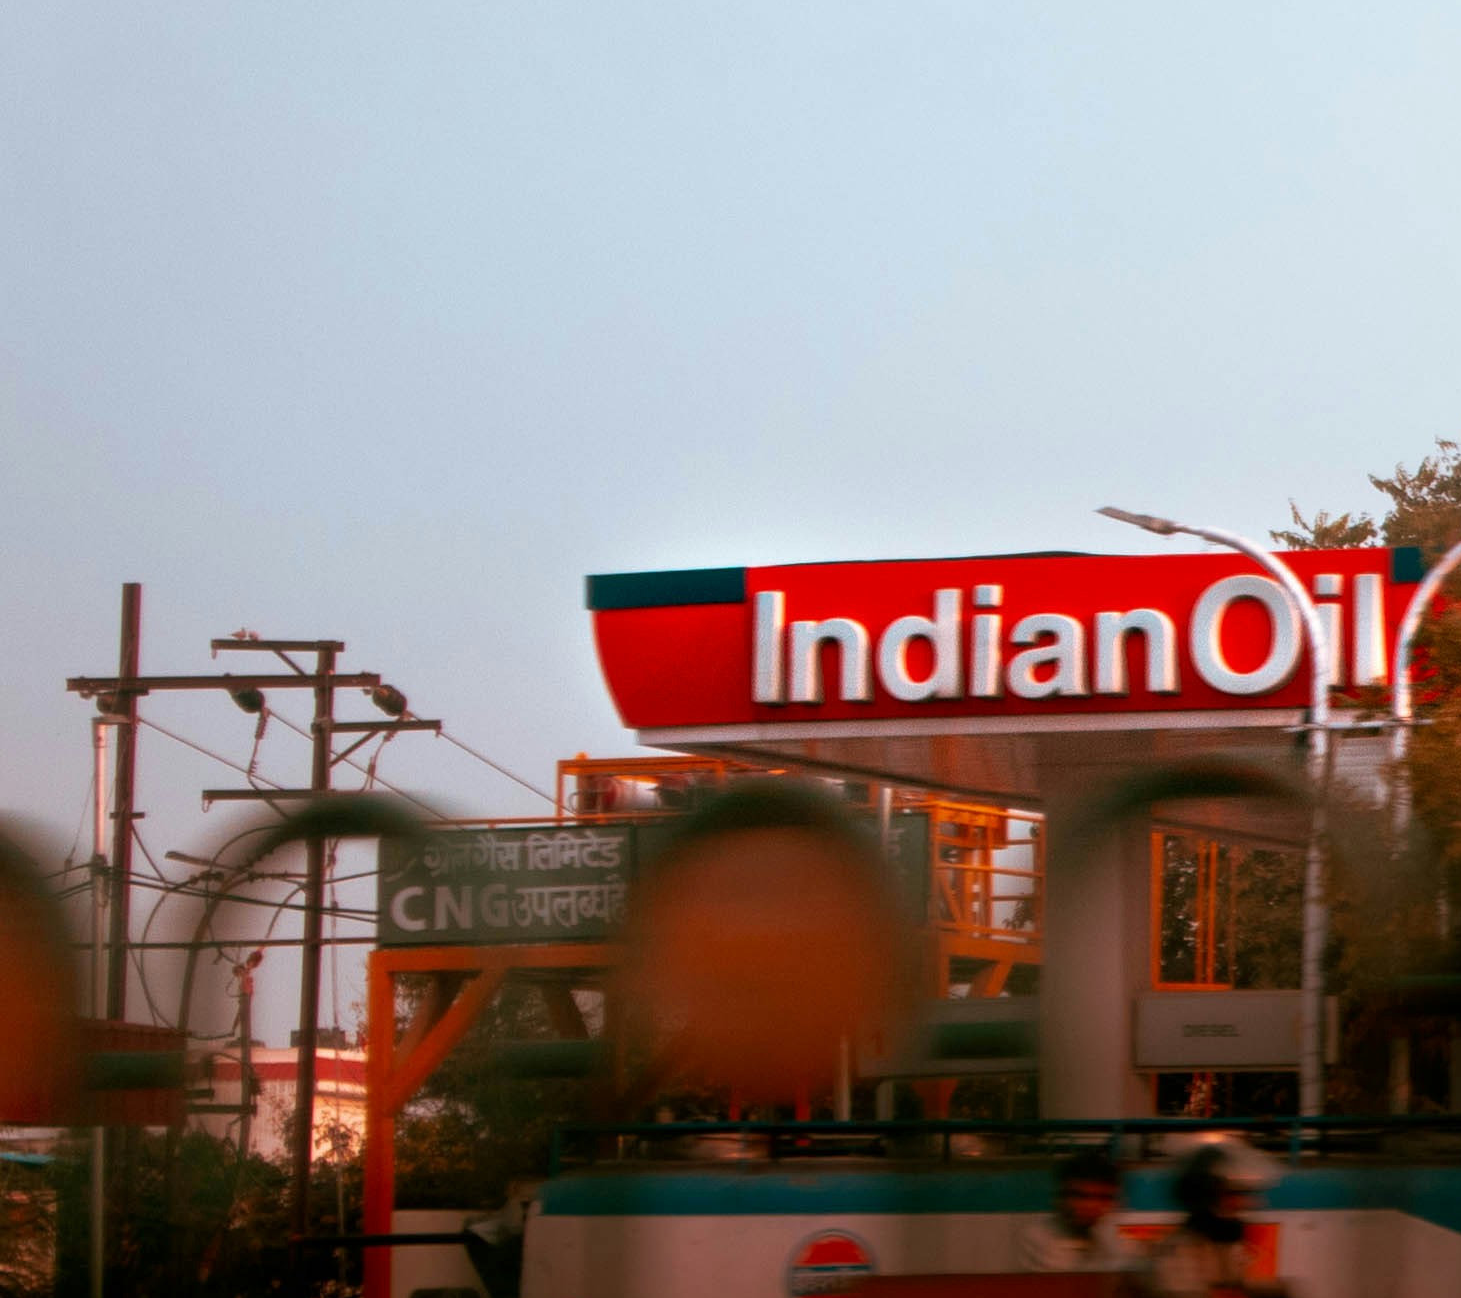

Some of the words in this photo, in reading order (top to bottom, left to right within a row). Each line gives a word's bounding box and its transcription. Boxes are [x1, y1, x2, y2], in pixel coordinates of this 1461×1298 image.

[751, 573, 1388, 704] IndianOil
[526, 831, 624, 871] लिमिटेड
[391, 881, 510, 932] CNG
